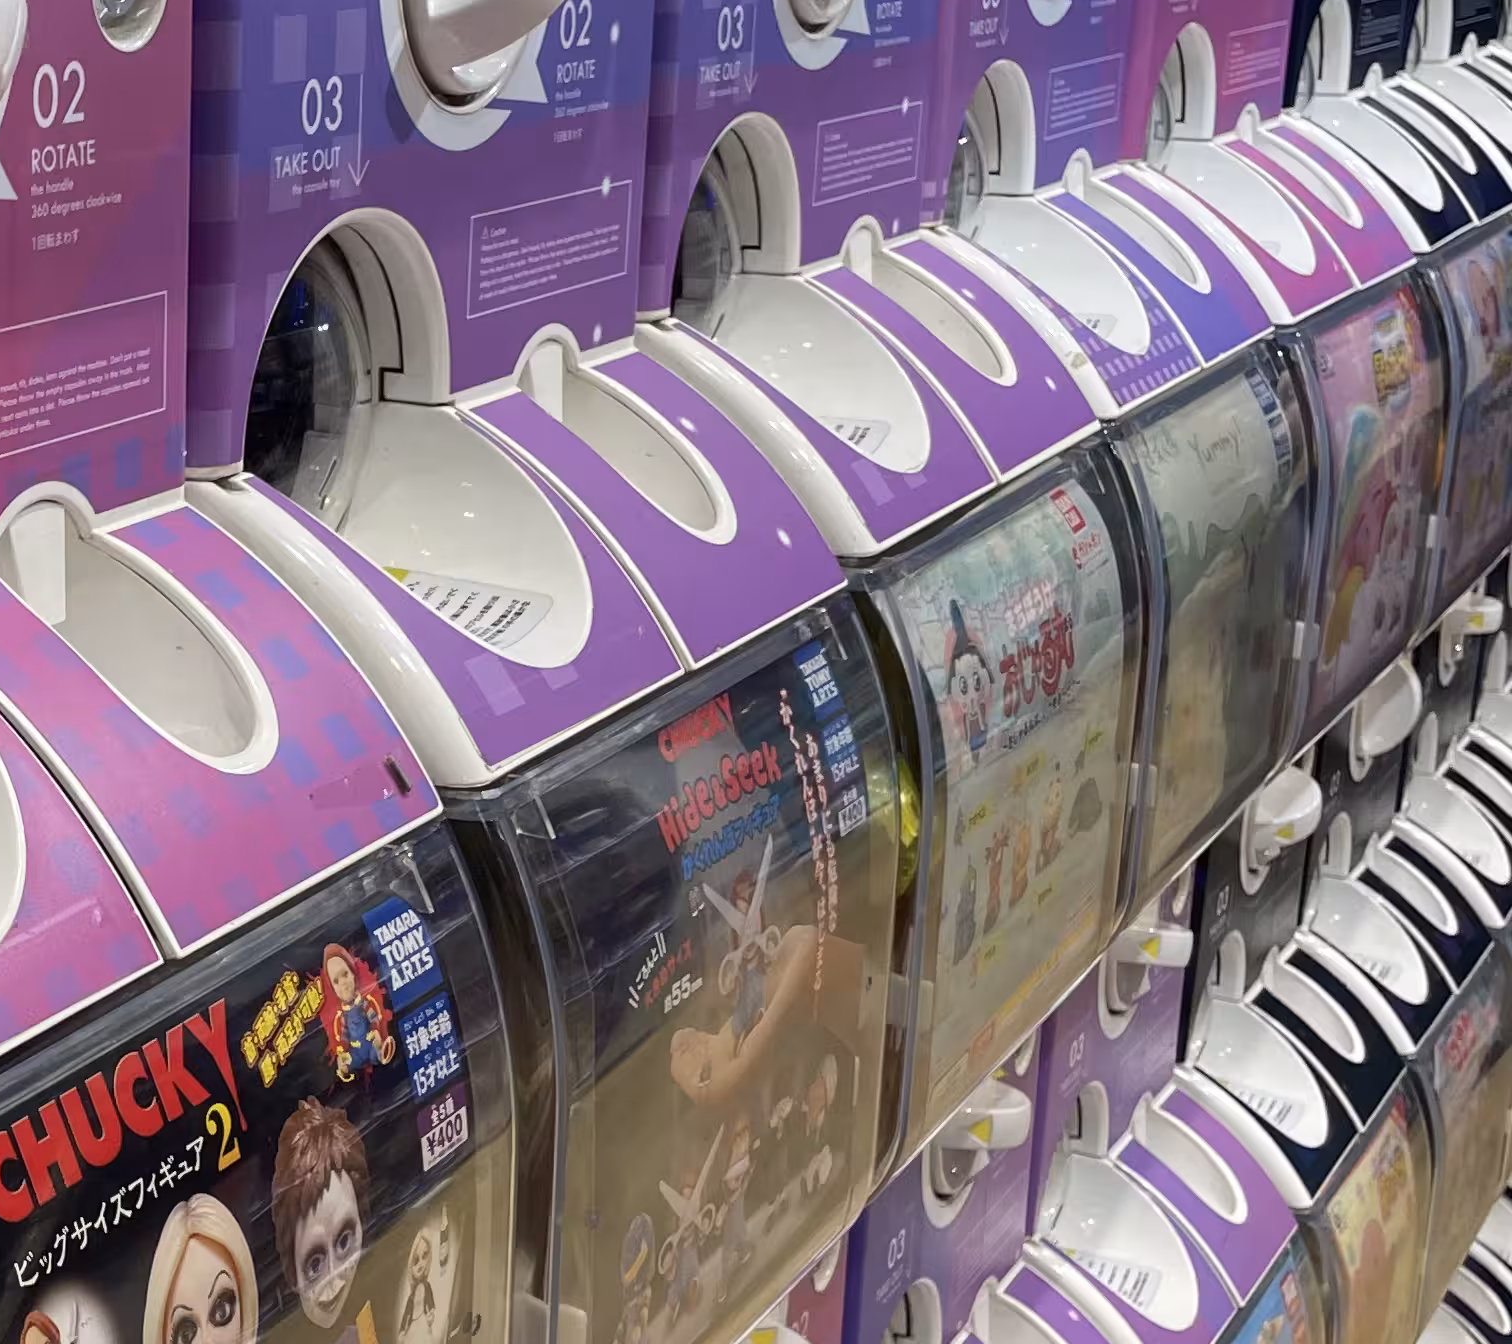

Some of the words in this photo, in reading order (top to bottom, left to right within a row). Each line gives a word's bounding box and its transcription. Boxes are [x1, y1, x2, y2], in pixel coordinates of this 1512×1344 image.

[717, 5, 745, 52] 03
[556, 59, 596, 84] ROTATE
[33, 60, 86, 129] 02
[301, 75, 343, 135] 03
[31, 139, 97, 175] ROTATE
[274, 149, 310, 180] TAKE
[312, 145, 342, 173] OUT
[373, 909, 420, 946] TAKARA
[380, 926, 426, 967] TOMY
[406, 1009, 453, 1059] 対象年齢
[413, 1051, 461, 1097] 15才以上
[426, 1113, 463, 1156] ¥400
[13, 1135, 206, 1288] ビッグサイズフィギュア
[205, 1103, 242, 1173] 2
